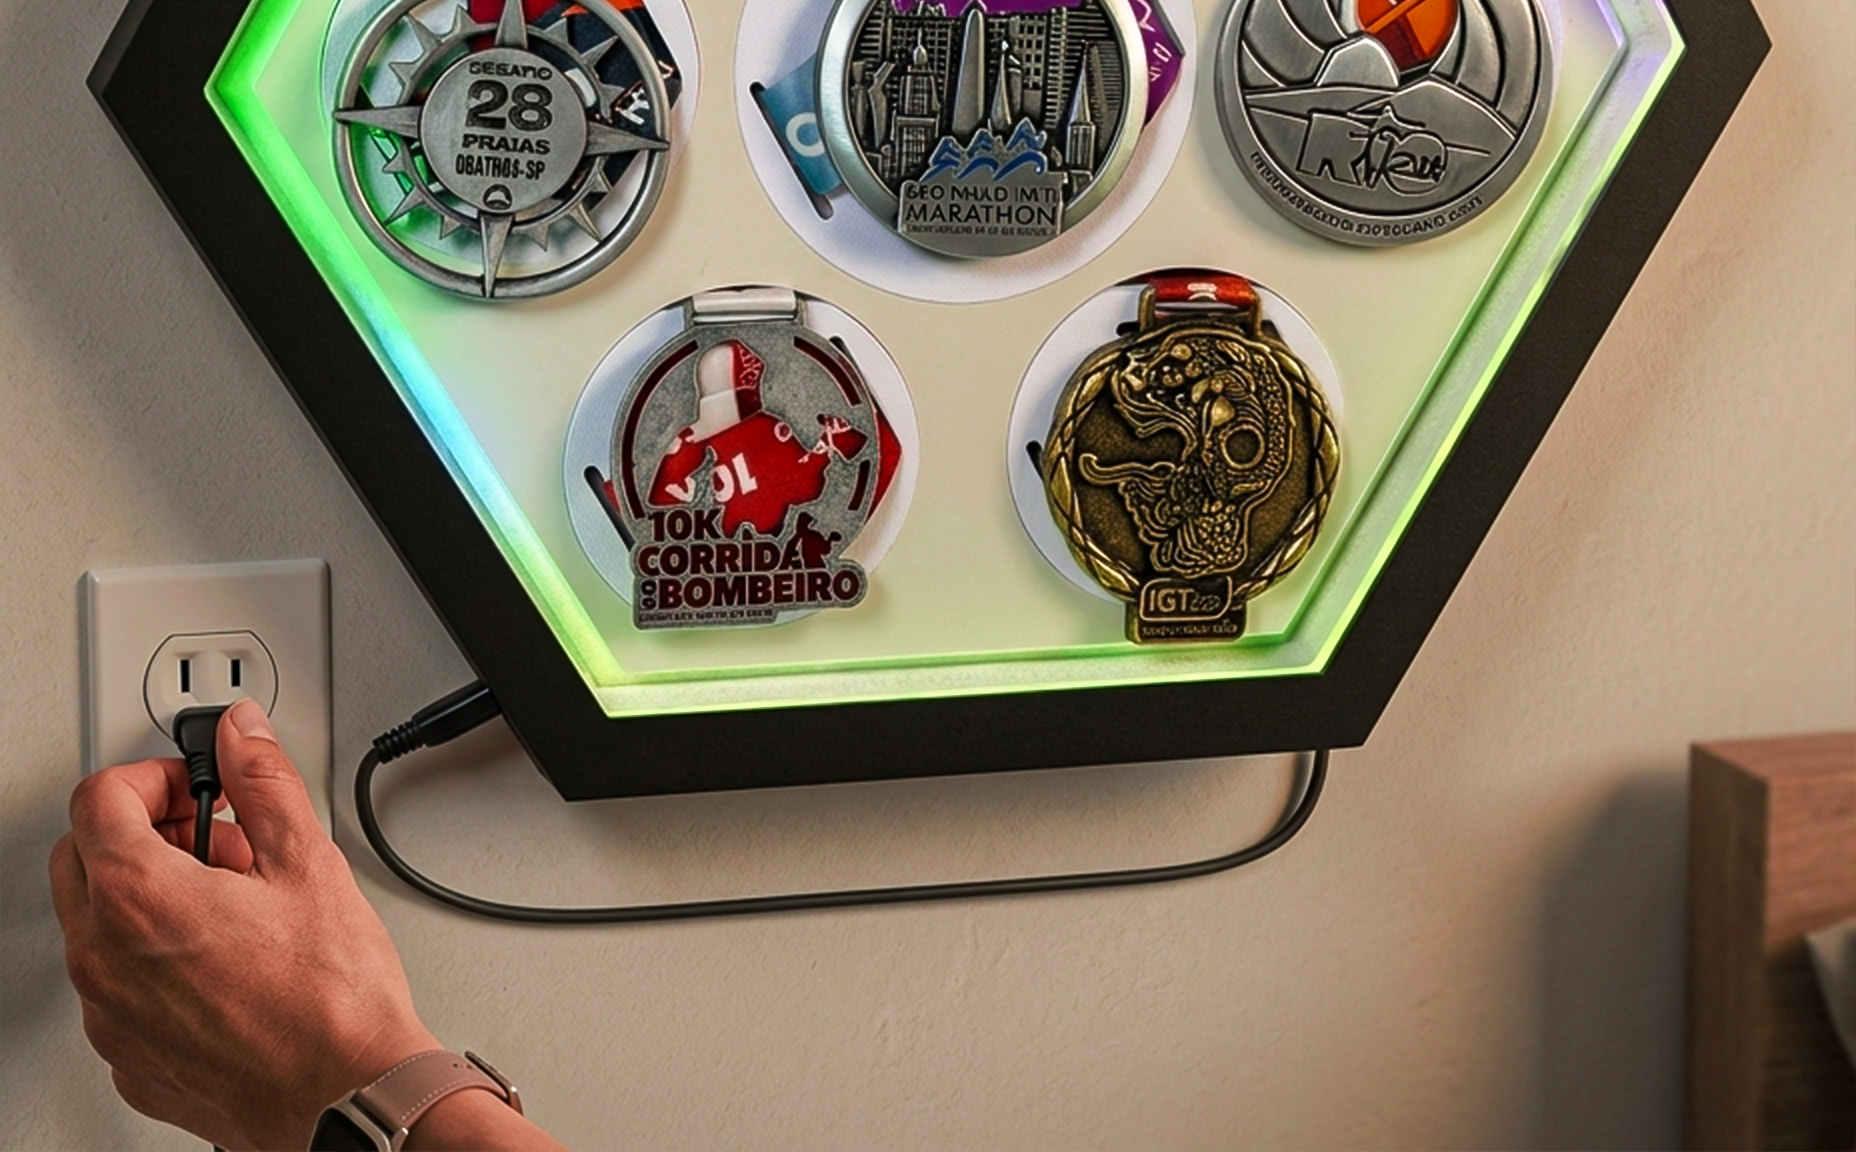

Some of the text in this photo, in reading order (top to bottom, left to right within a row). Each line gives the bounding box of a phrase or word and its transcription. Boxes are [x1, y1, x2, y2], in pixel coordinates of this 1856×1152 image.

[465, 79, 553, 132] 28
[461, 133, 551, 156] PRAIAS
[905, 202, 1057, 226] MARATHON
[647, 508, 722, 542] 10K
[638, 540, 801, 577] CORRIDA
[658, 568, 860, 609] BOMBEIRO
